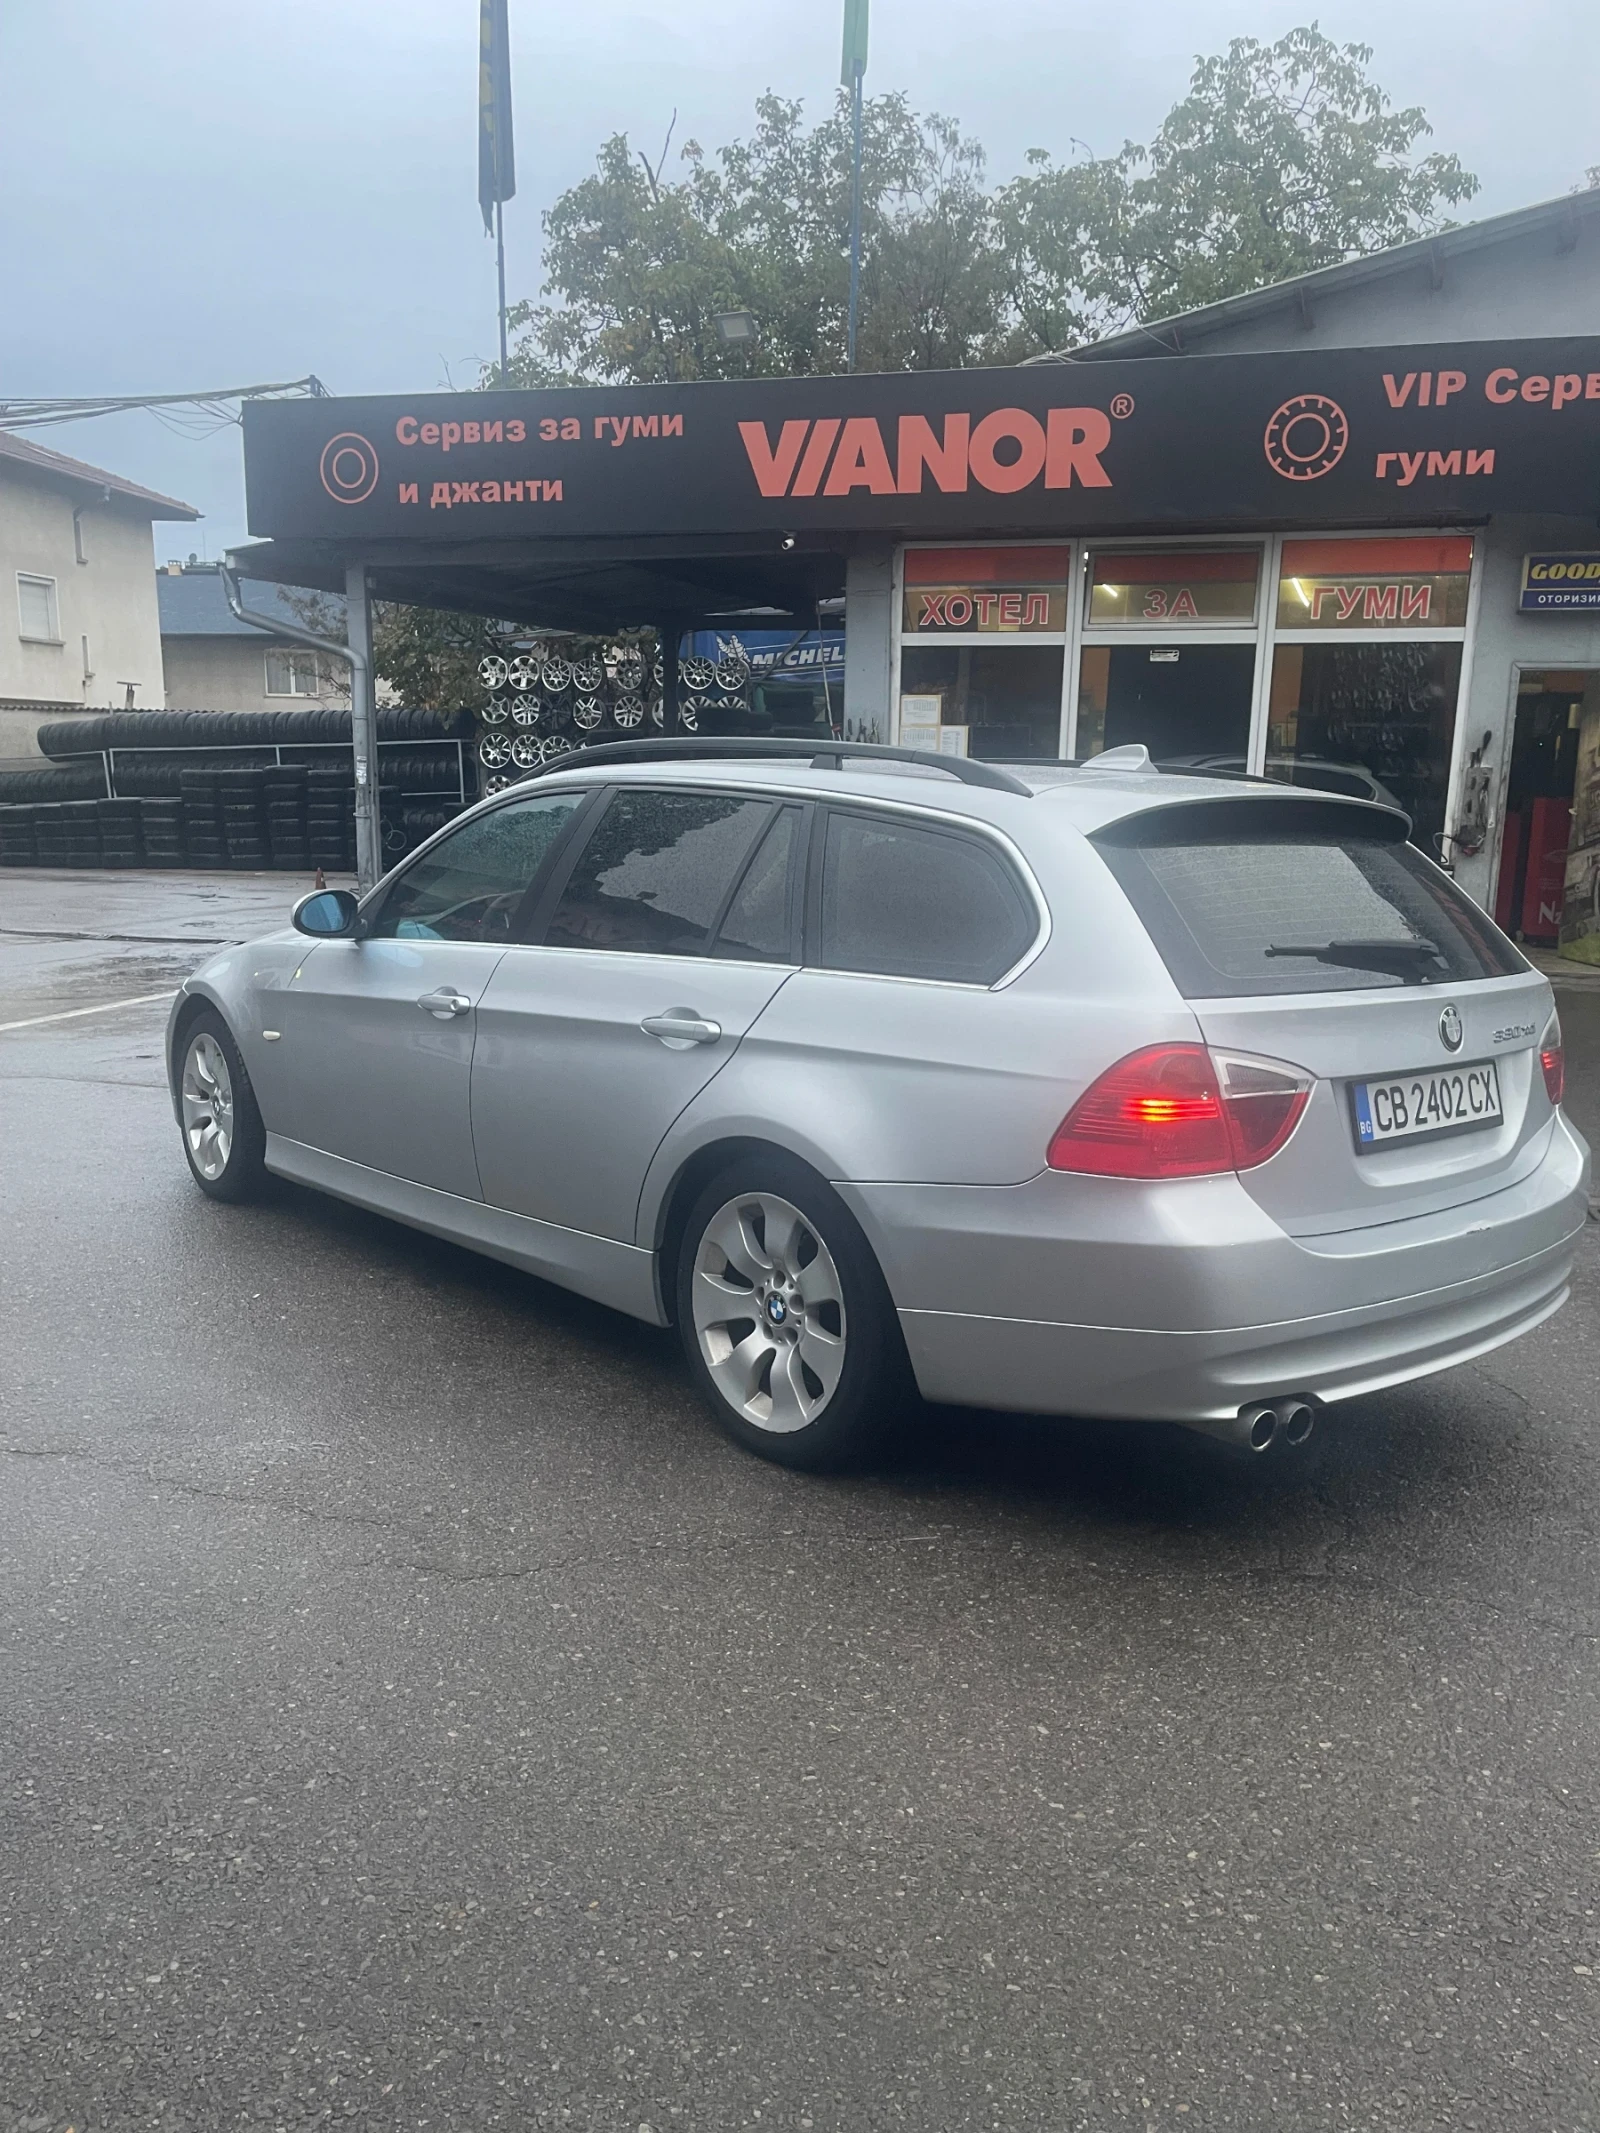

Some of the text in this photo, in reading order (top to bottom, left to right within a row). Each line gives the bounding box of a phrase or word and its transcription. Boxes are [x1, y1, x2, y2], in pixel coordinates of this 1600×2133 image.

[1382, 370, 1467, 408] VIP
[396, 413, 684, 452] Сервиз за гуми
[1375, 449, 1496, 486] гуми
[399, 478, 564, 508] и джанти
[1531, 562, 1600, 580] GOOD
[919, 584, 1432, 627] ХОТЕЛ ЗА ГУМИ
[752, 646, 846, 666] MCHEL
[1373, 1070, 1496, 1132] CB 2402 CX
[1360, 1120, 1372, 1135] BG
